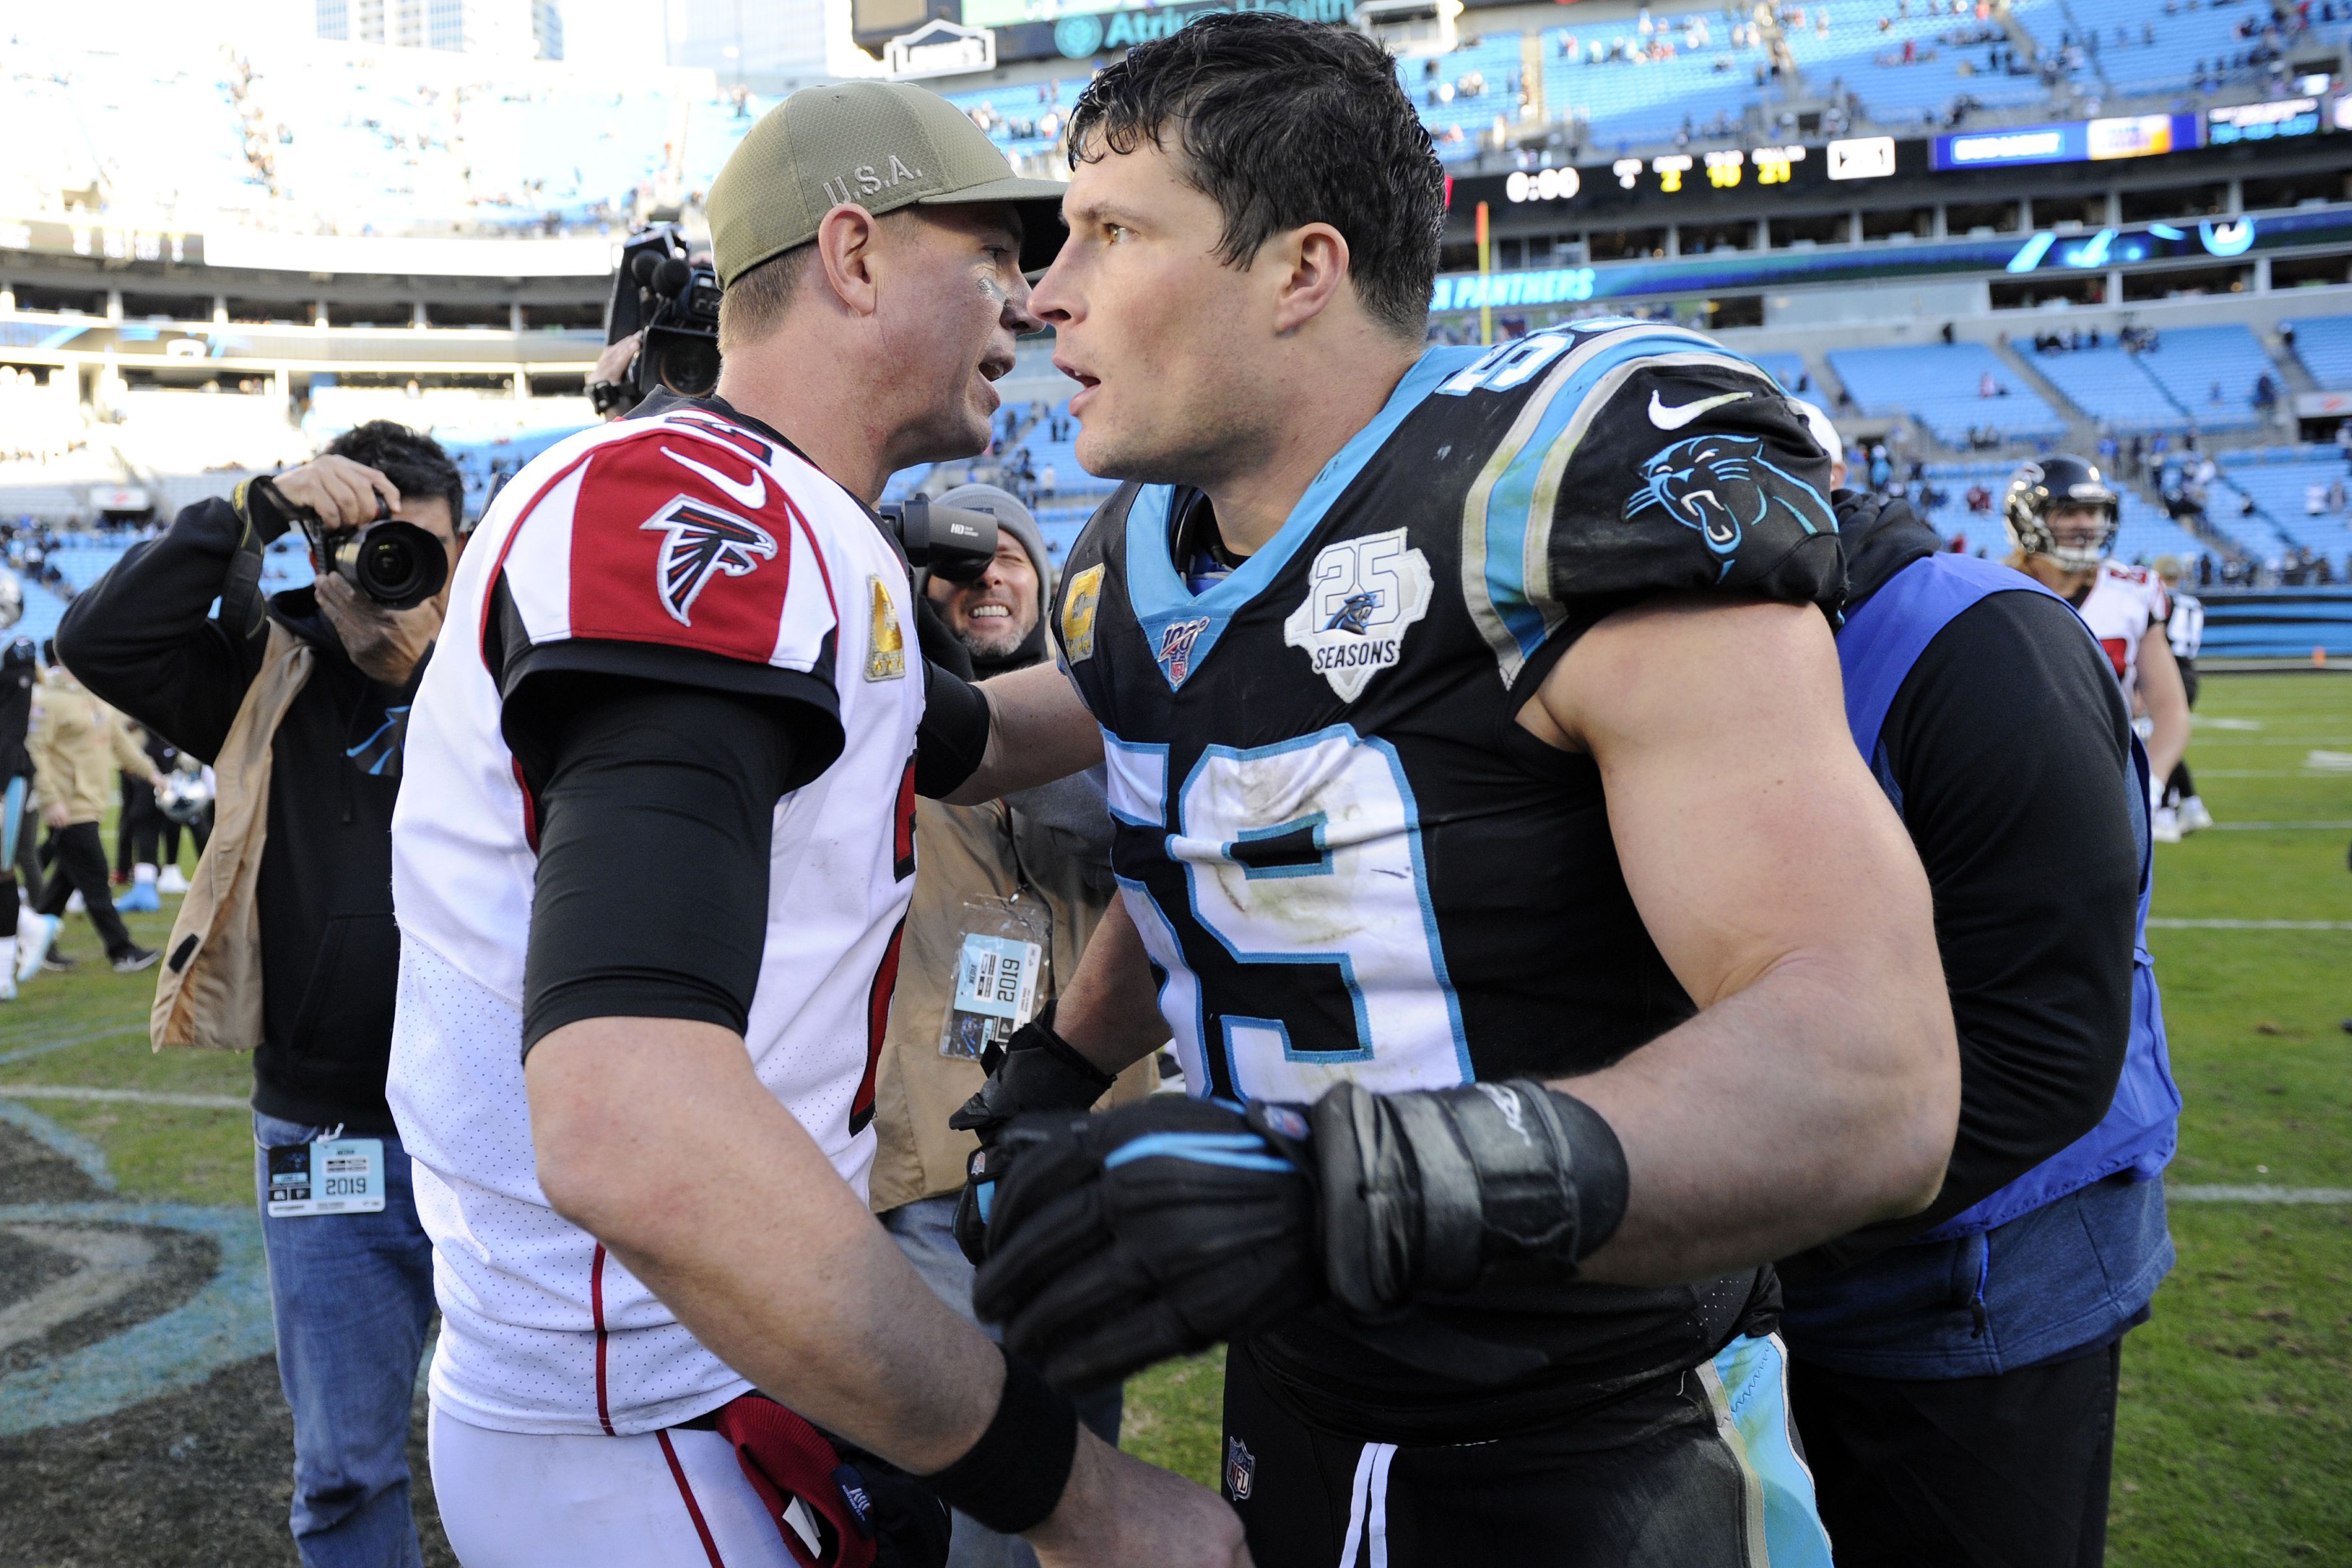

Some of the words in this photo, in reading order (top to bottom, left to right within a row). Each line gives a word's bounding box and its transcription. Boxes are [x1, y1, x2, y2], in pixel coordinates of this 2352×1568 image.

[823, 155, 923, 208] U.S.A.
[1063, 572, 1099, 639] C
[1313, 536, 1401, 634] 25
[1315, 639, 1397, 670] SEASONS
[1102, 723, 1476, 1108] 59
[997, 958, 1020, 1003] 2019
[326, 1177, 366, 1196] 2019
[1229, 1460, 1248, 1493] NFL
